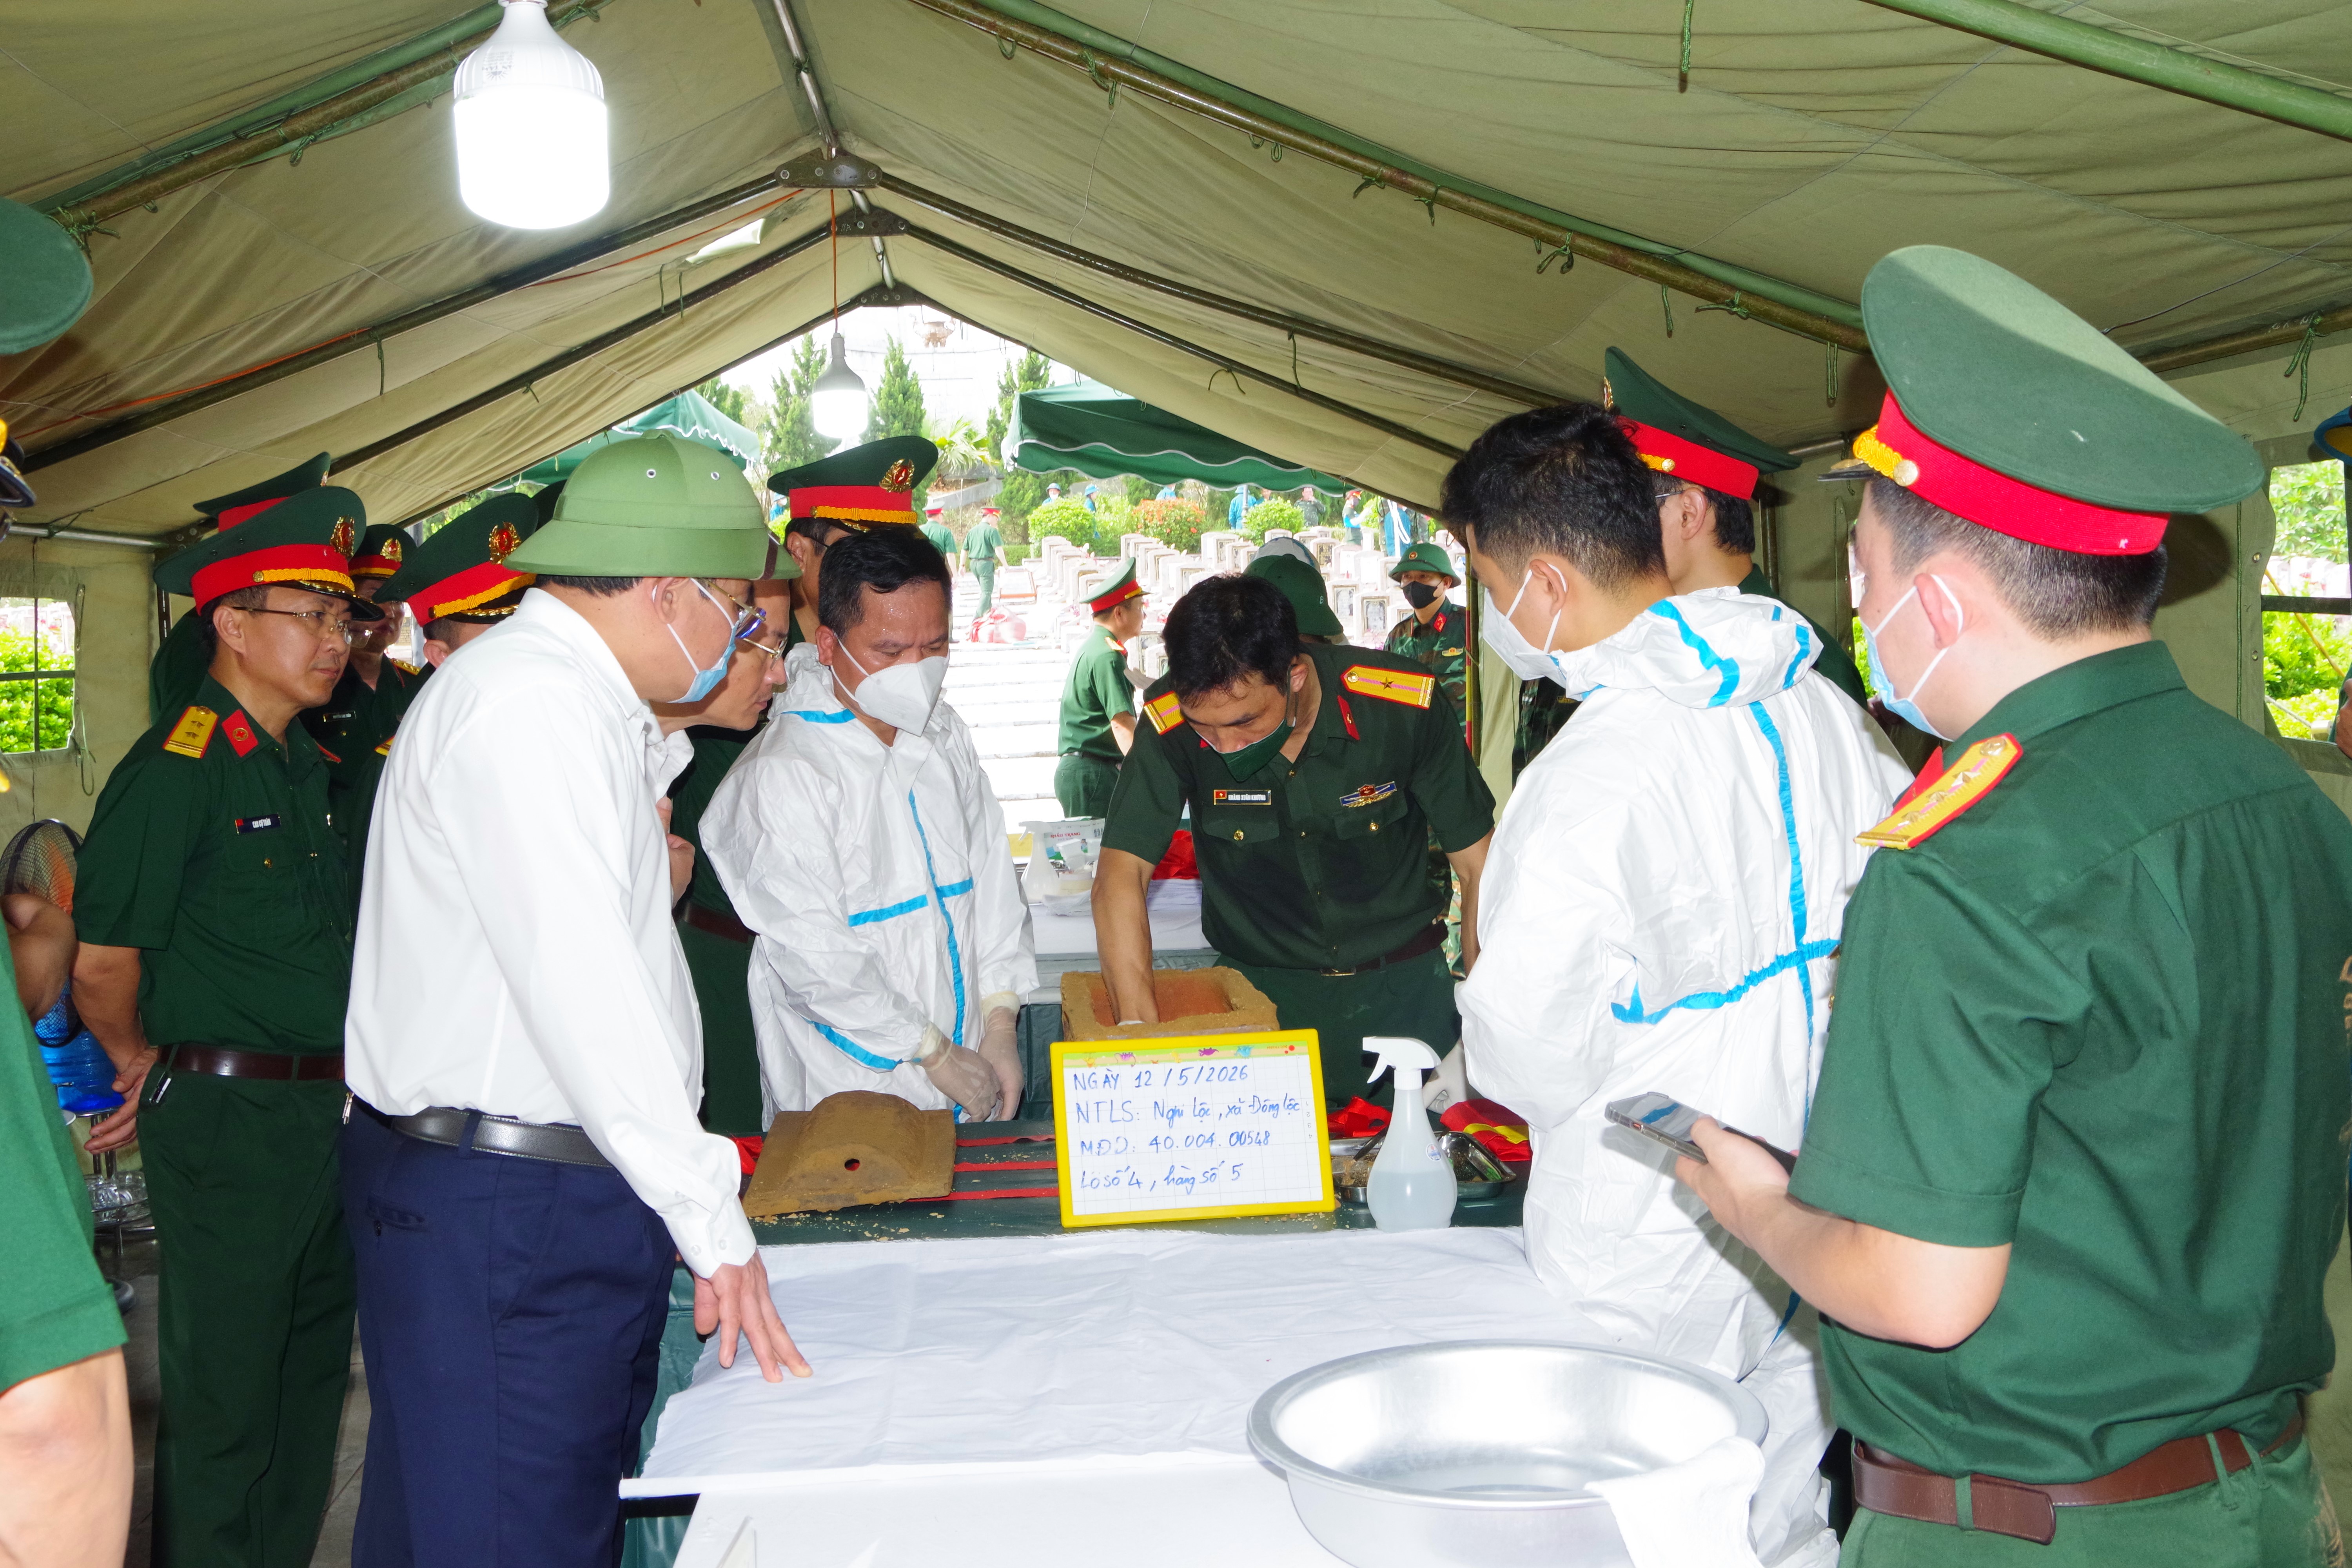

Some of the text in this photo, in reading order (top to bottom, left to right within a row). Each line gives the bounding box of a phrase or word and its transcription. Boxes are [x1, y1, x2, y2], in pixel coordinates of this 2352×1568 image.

[1073, 1068, 1120, 1090] NGÀY
[1076, 1099, 1140, 1123] NTLS:
[1231, 1163, 1244, 1181] 5
